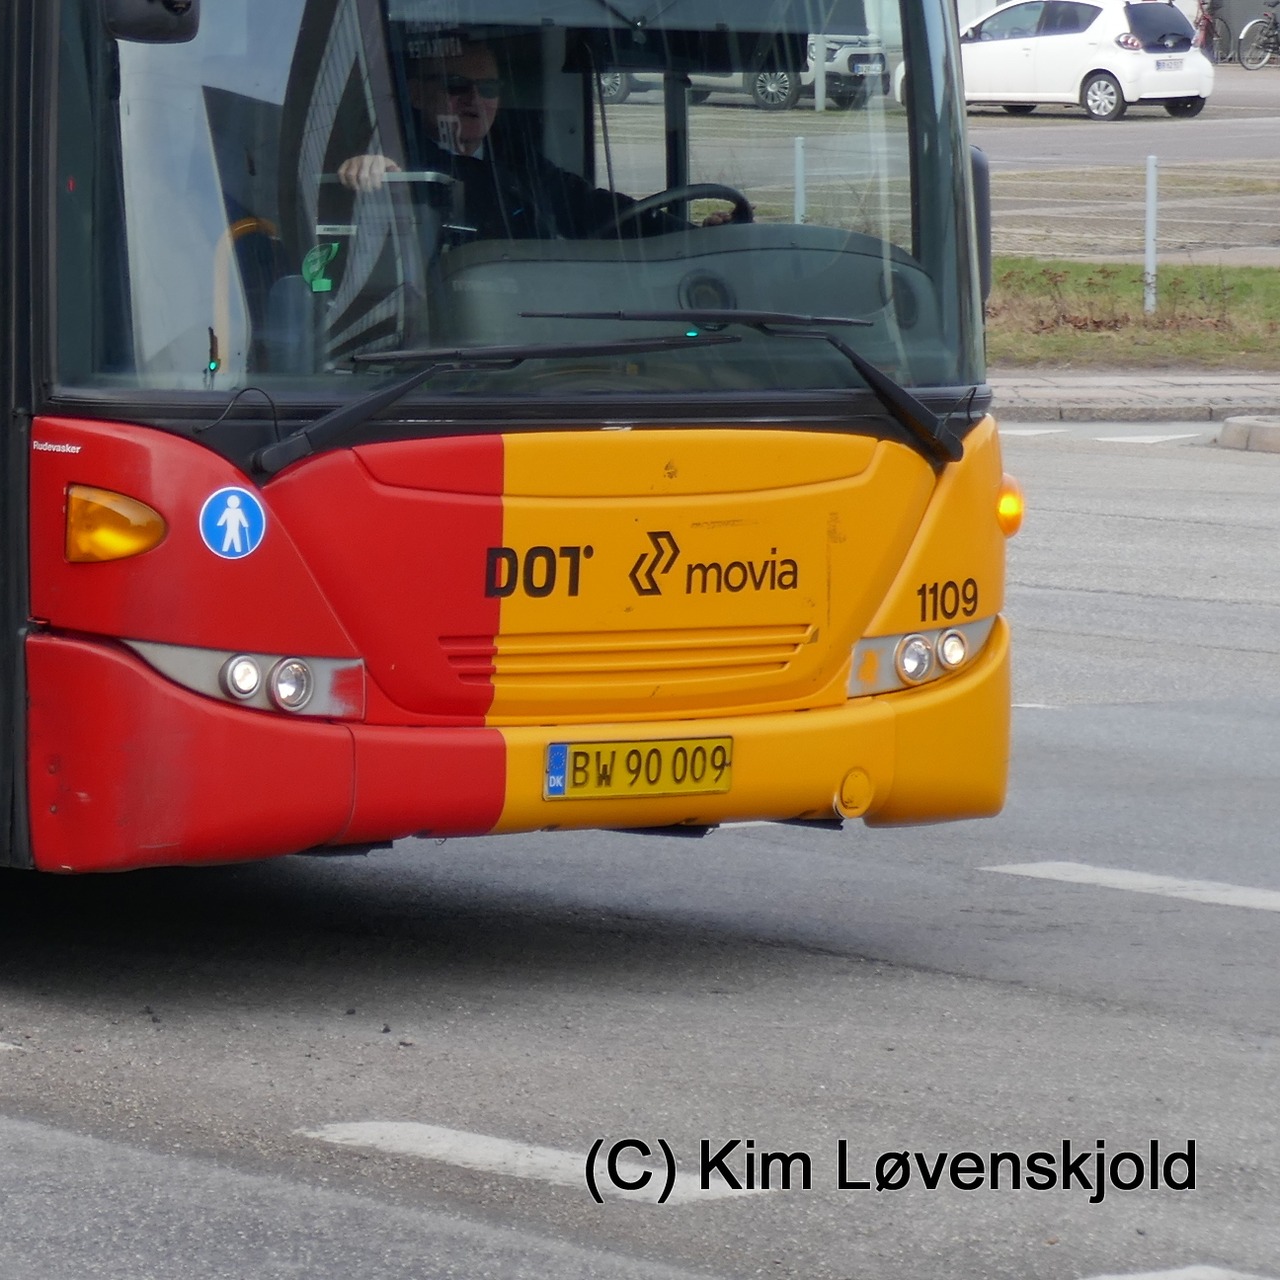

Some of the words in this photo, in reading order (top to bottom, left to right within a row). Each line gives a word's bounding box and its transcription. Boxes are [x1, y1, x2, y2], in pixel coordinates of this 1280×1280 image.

[485, 544, 593, 599] DOT
[684, 546, 799, 595] movia
[916, 579, 979, 624] 1109
[548, 775, 564, 788] DK
[569, 750, 619, 789] BW
[623, 748, 667, 787] 90
[671, 745, 728, 785] 009
